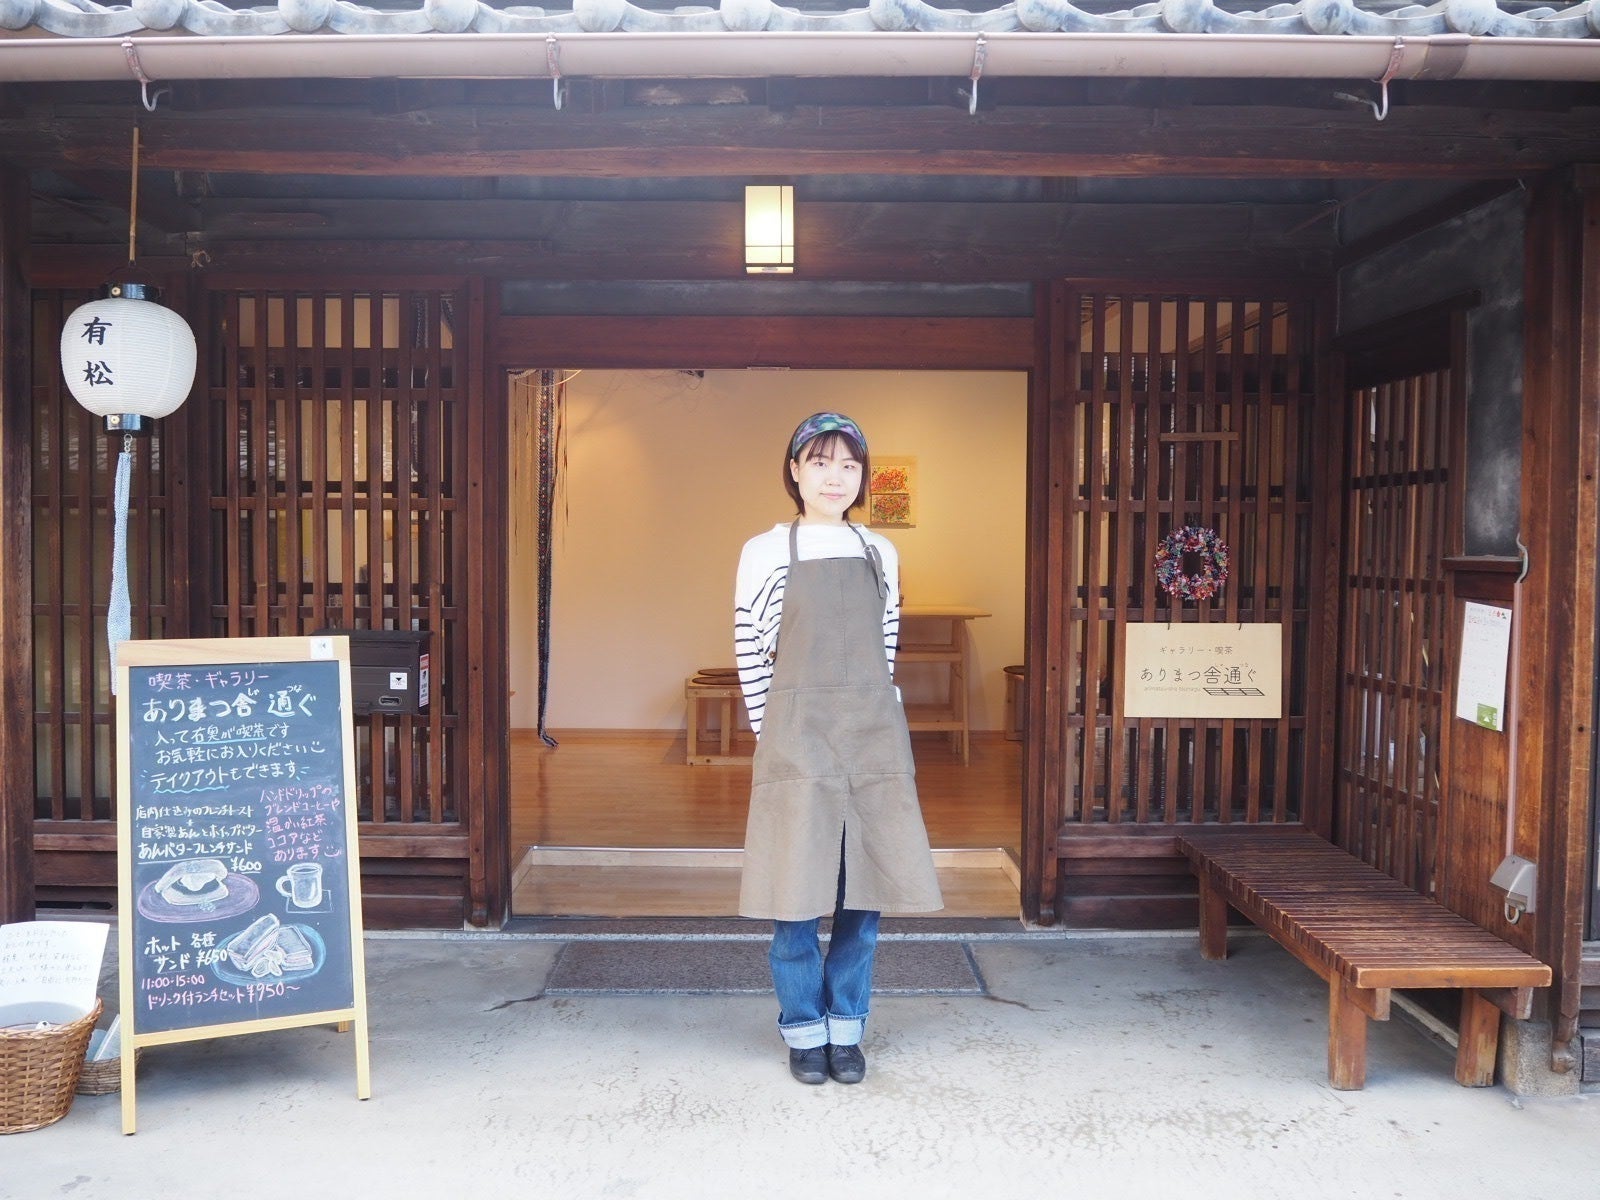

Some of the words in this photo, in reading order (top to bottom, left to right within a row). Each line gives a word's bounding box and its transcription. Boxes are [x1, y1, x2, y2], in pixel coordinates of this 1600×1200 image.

[81, 316, 114, 387] 有松
[1159, 646, 1233, 655] ギャラリー・喫茶
[148, 670, 269, 692] 喫茶・ギャラリー
[1140, 666, 1257, 684] ありまつ舎通ぐ
[155, 722, 290, 746] 入って右奥が喫茶です
[138, 839, 254, 859] あんバターフレンチサンド
[267, 829, 323, 849] ココアなど
[274, 844, 320, 862] あります
[231, 856, 262, 872] ¥600
[144, 935, 181, 955] ホット
[191, 931, 217, 948] 各種
[153, 953, 190, 974] サンド
[196, 949, 228, 969] ¥650
[141, 974, 205, 990] 11:00-15:00
